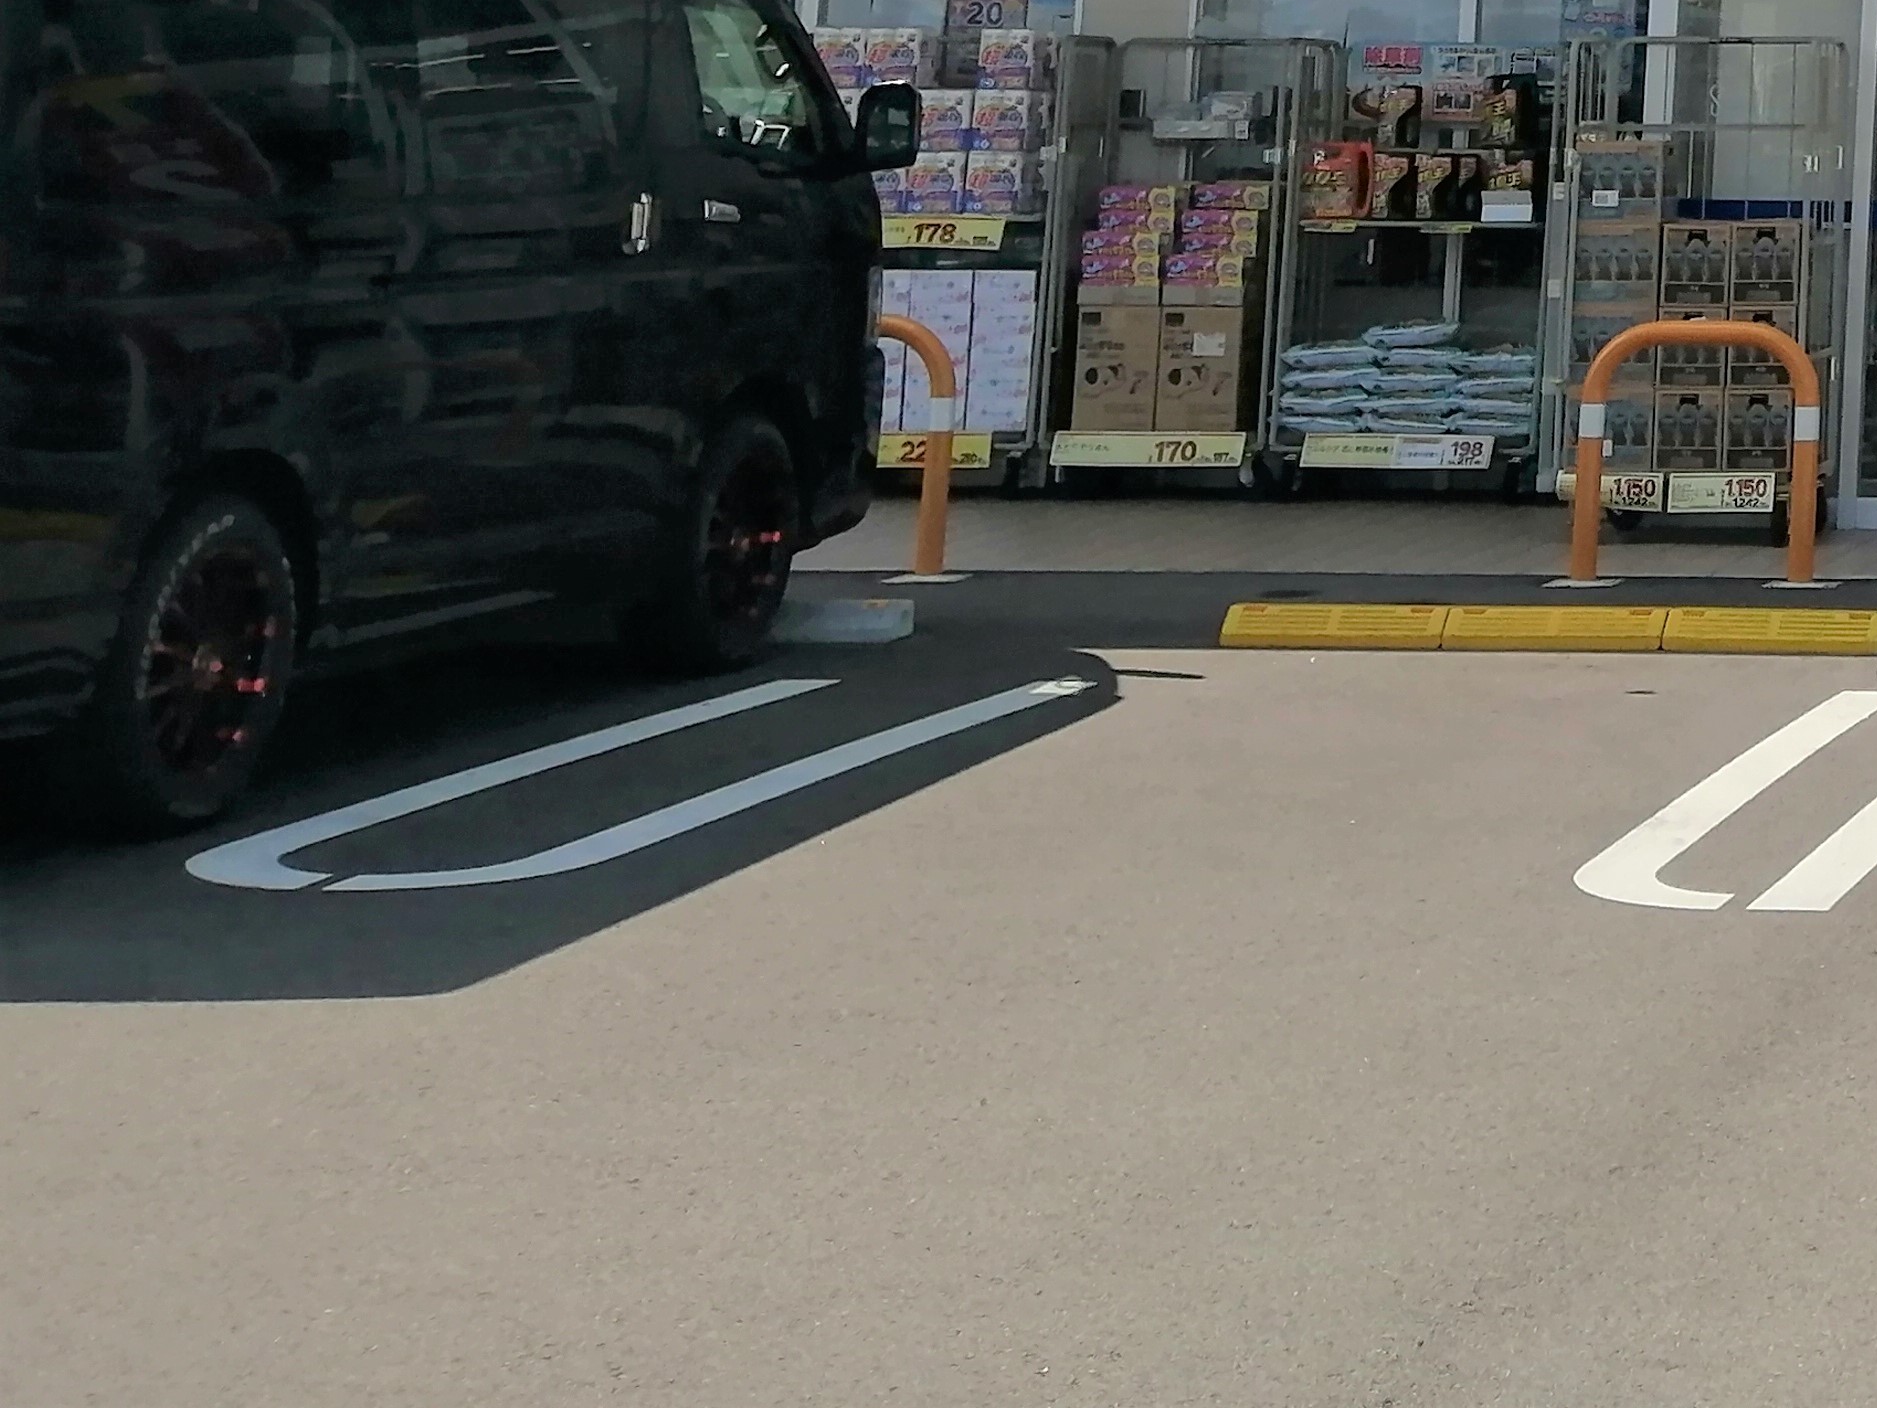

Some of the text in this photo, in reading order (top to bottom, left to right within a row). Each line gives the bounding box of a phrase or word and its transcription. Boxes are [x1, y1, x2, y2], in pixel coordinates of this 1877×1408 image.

[914, 222, 957, 243] 178
[1154, 440, 1197, 463] 170
[1450, 441, 1483, 456] 198
